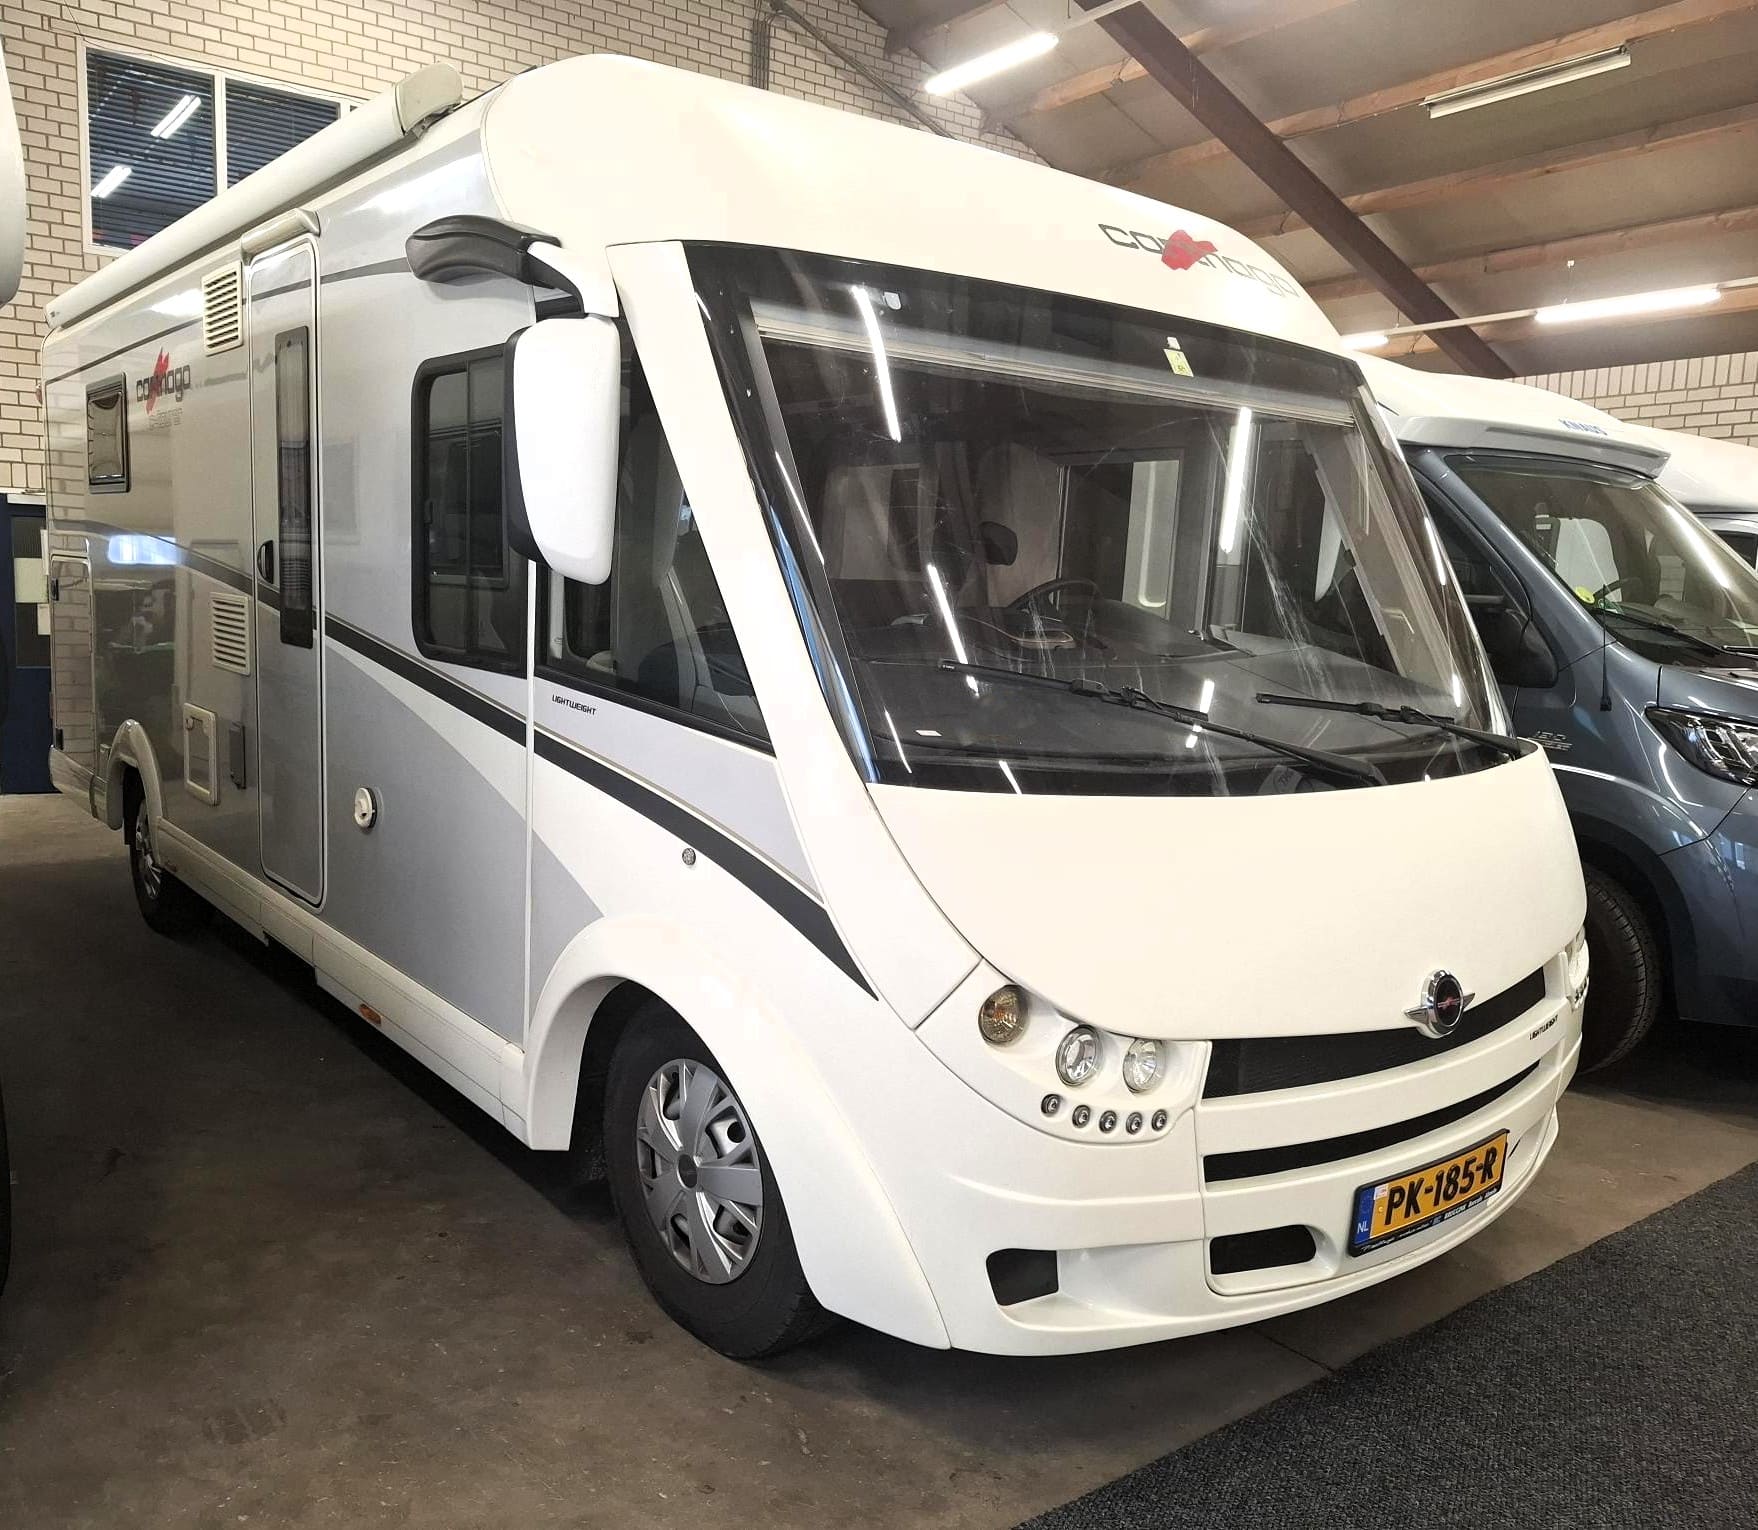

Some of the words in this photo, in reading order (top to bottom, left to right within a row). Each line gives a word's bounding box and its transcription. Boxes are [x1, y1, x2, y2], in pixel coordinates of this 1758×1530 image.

[1097, 223, 1301, 298] cahago
[136, 364, 191, 403] cahago
[551, 694, 597, 716] LIGHTWEIGHT
[1384, 1146, 1498, 1226] PK-185-R
[1356, 1220, 1369, 1234] NL
